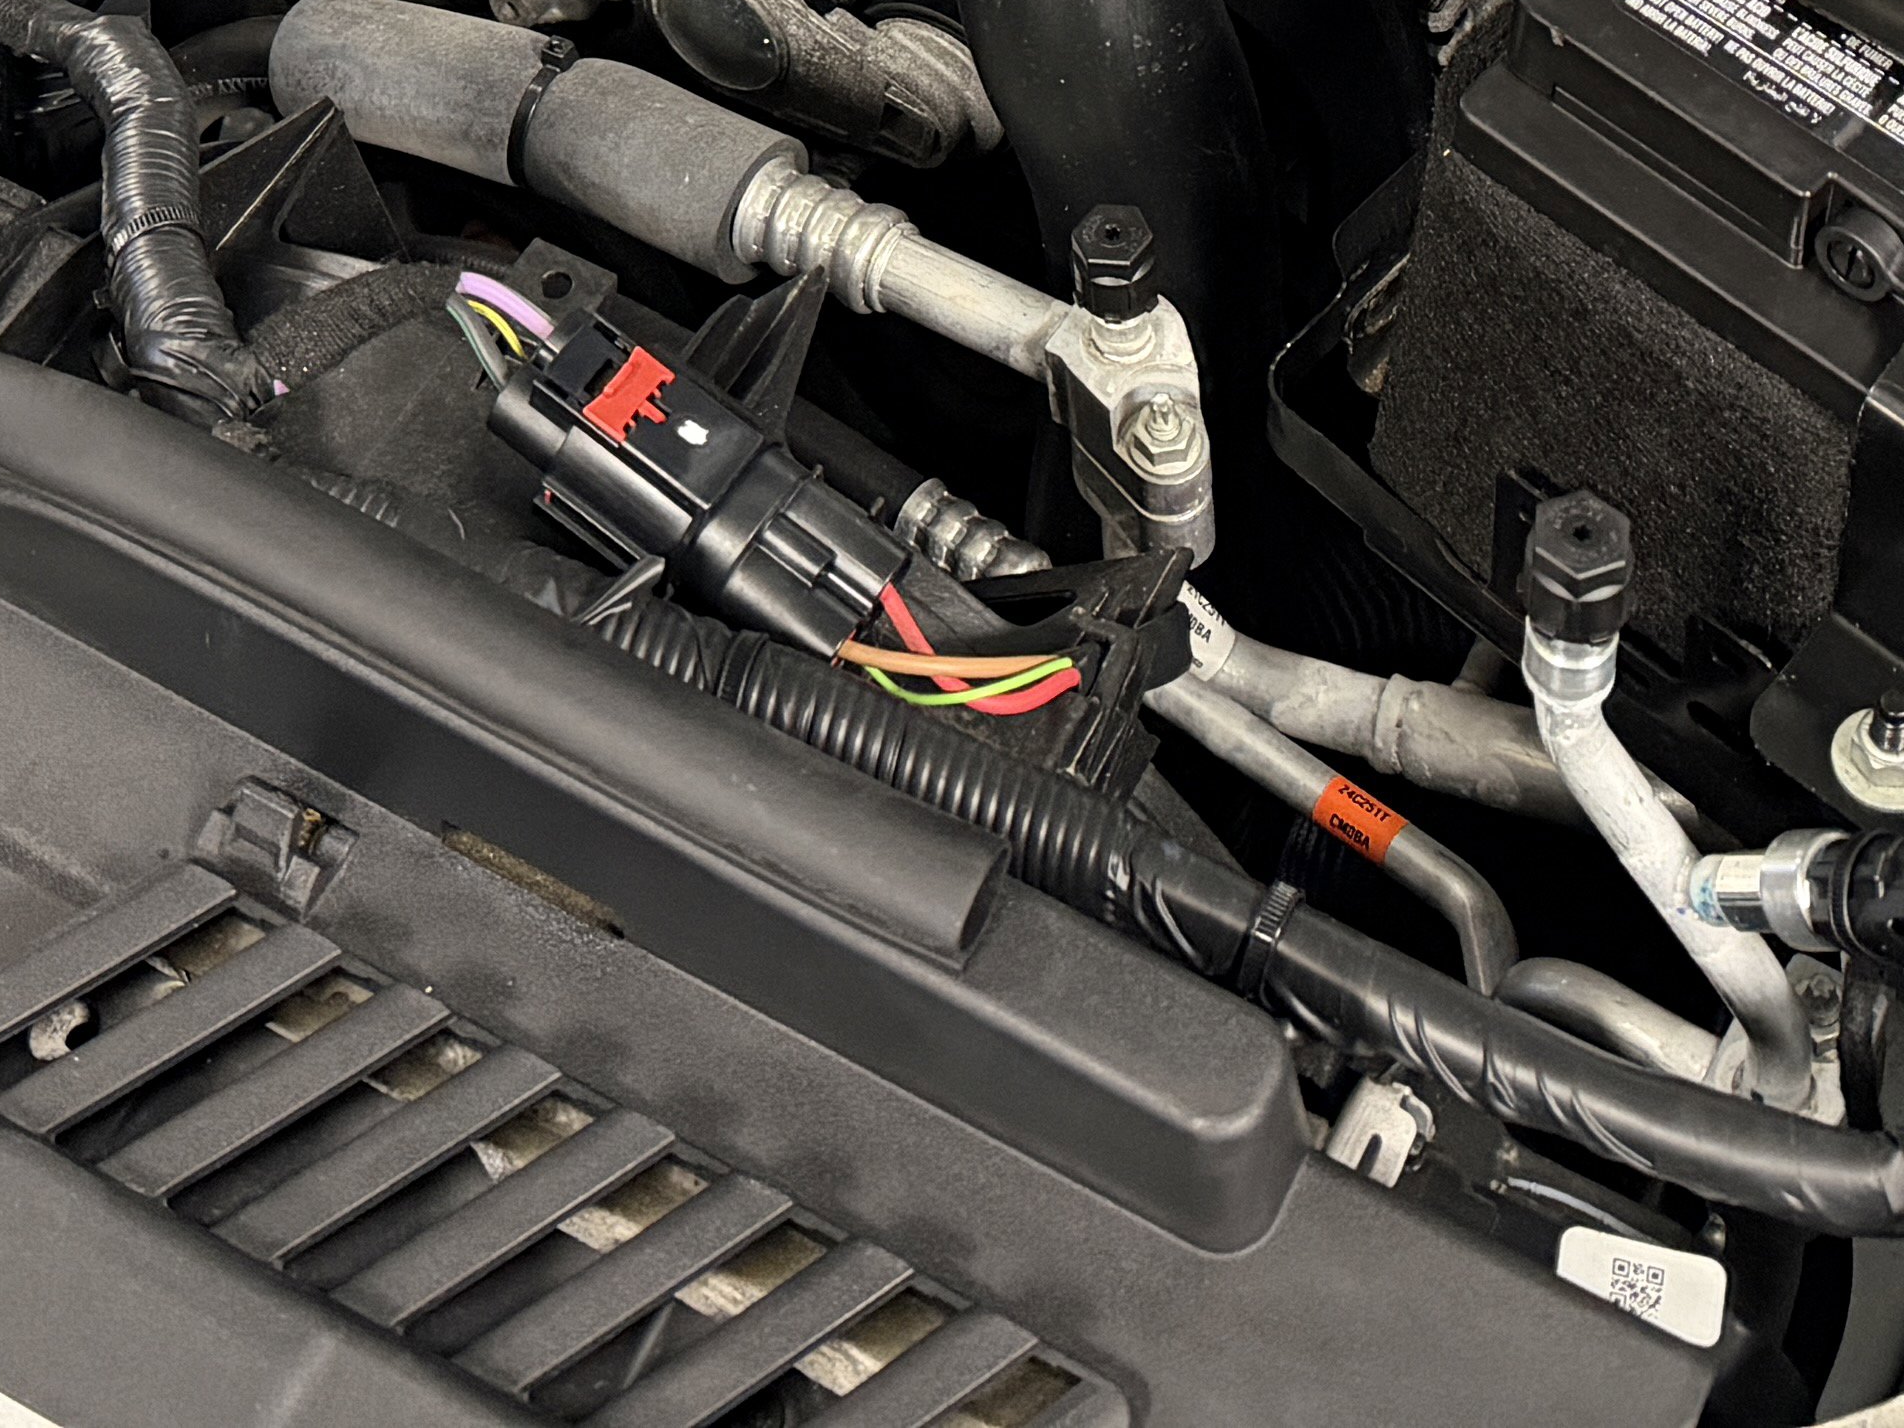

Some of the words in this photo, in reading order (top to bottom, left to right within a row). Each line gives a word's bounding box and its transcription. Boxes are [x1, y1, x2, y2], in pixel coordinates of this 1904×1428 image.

[1662, 17, 1678, 33] LA
[1844, 35, 1862, 50] DE
[1857, 43, 1894, 70] FUMER
[1780, 75, 1796, 91] LA
[1830, 68, 1846, 82] LA
